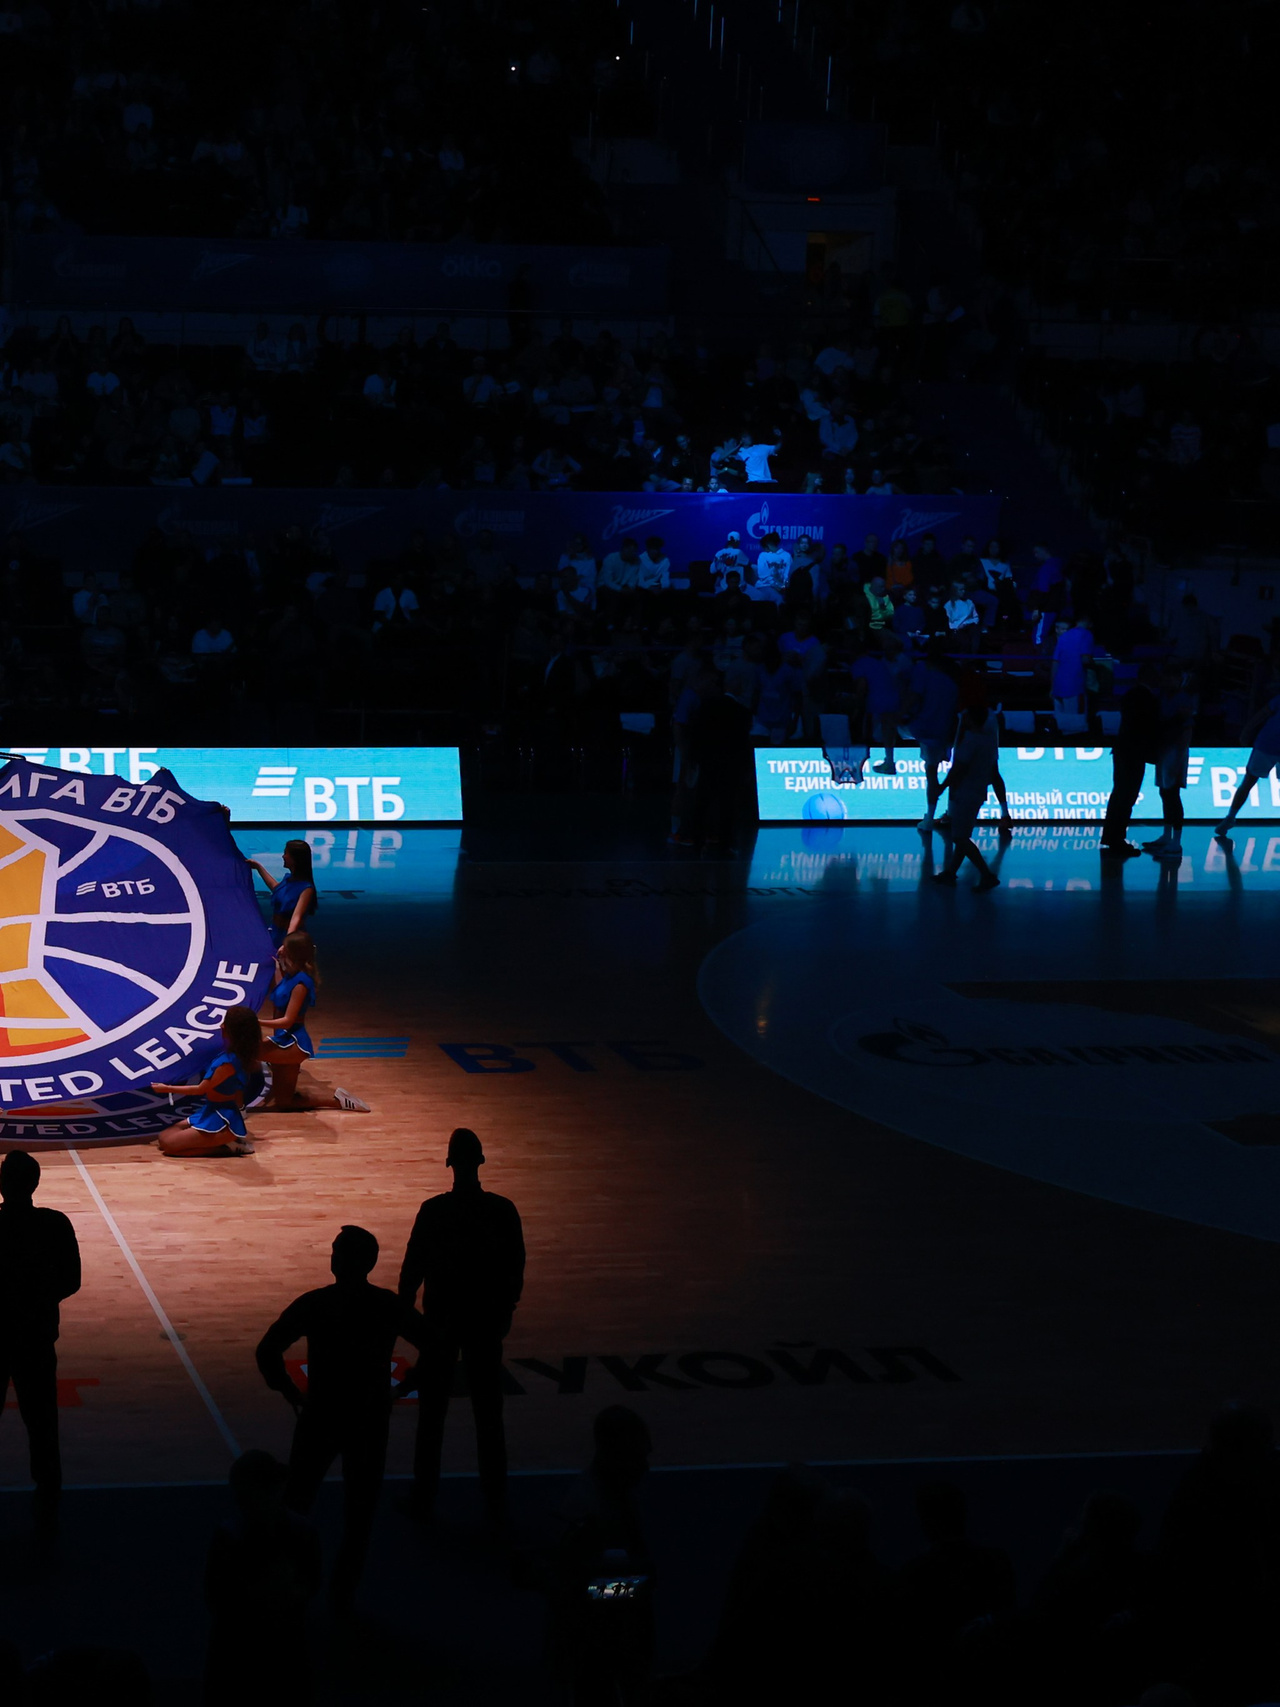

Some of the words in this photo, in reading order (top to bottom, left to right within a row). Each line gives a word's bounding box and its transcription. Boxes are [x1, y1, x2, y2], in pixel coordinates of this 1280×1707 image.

[305, 776, 405, 821] ВТБ
[859, 776, 905, 790] ЛИГИ
[907, 776, 928, 790] ВТ
[100, 785, 187, 825] ВТБ
[102, 877, 156, 899] ВТБ
[108, 960, 260, 1081] LEAGUE
[437, 1040, 707, 1075] ВТБ
